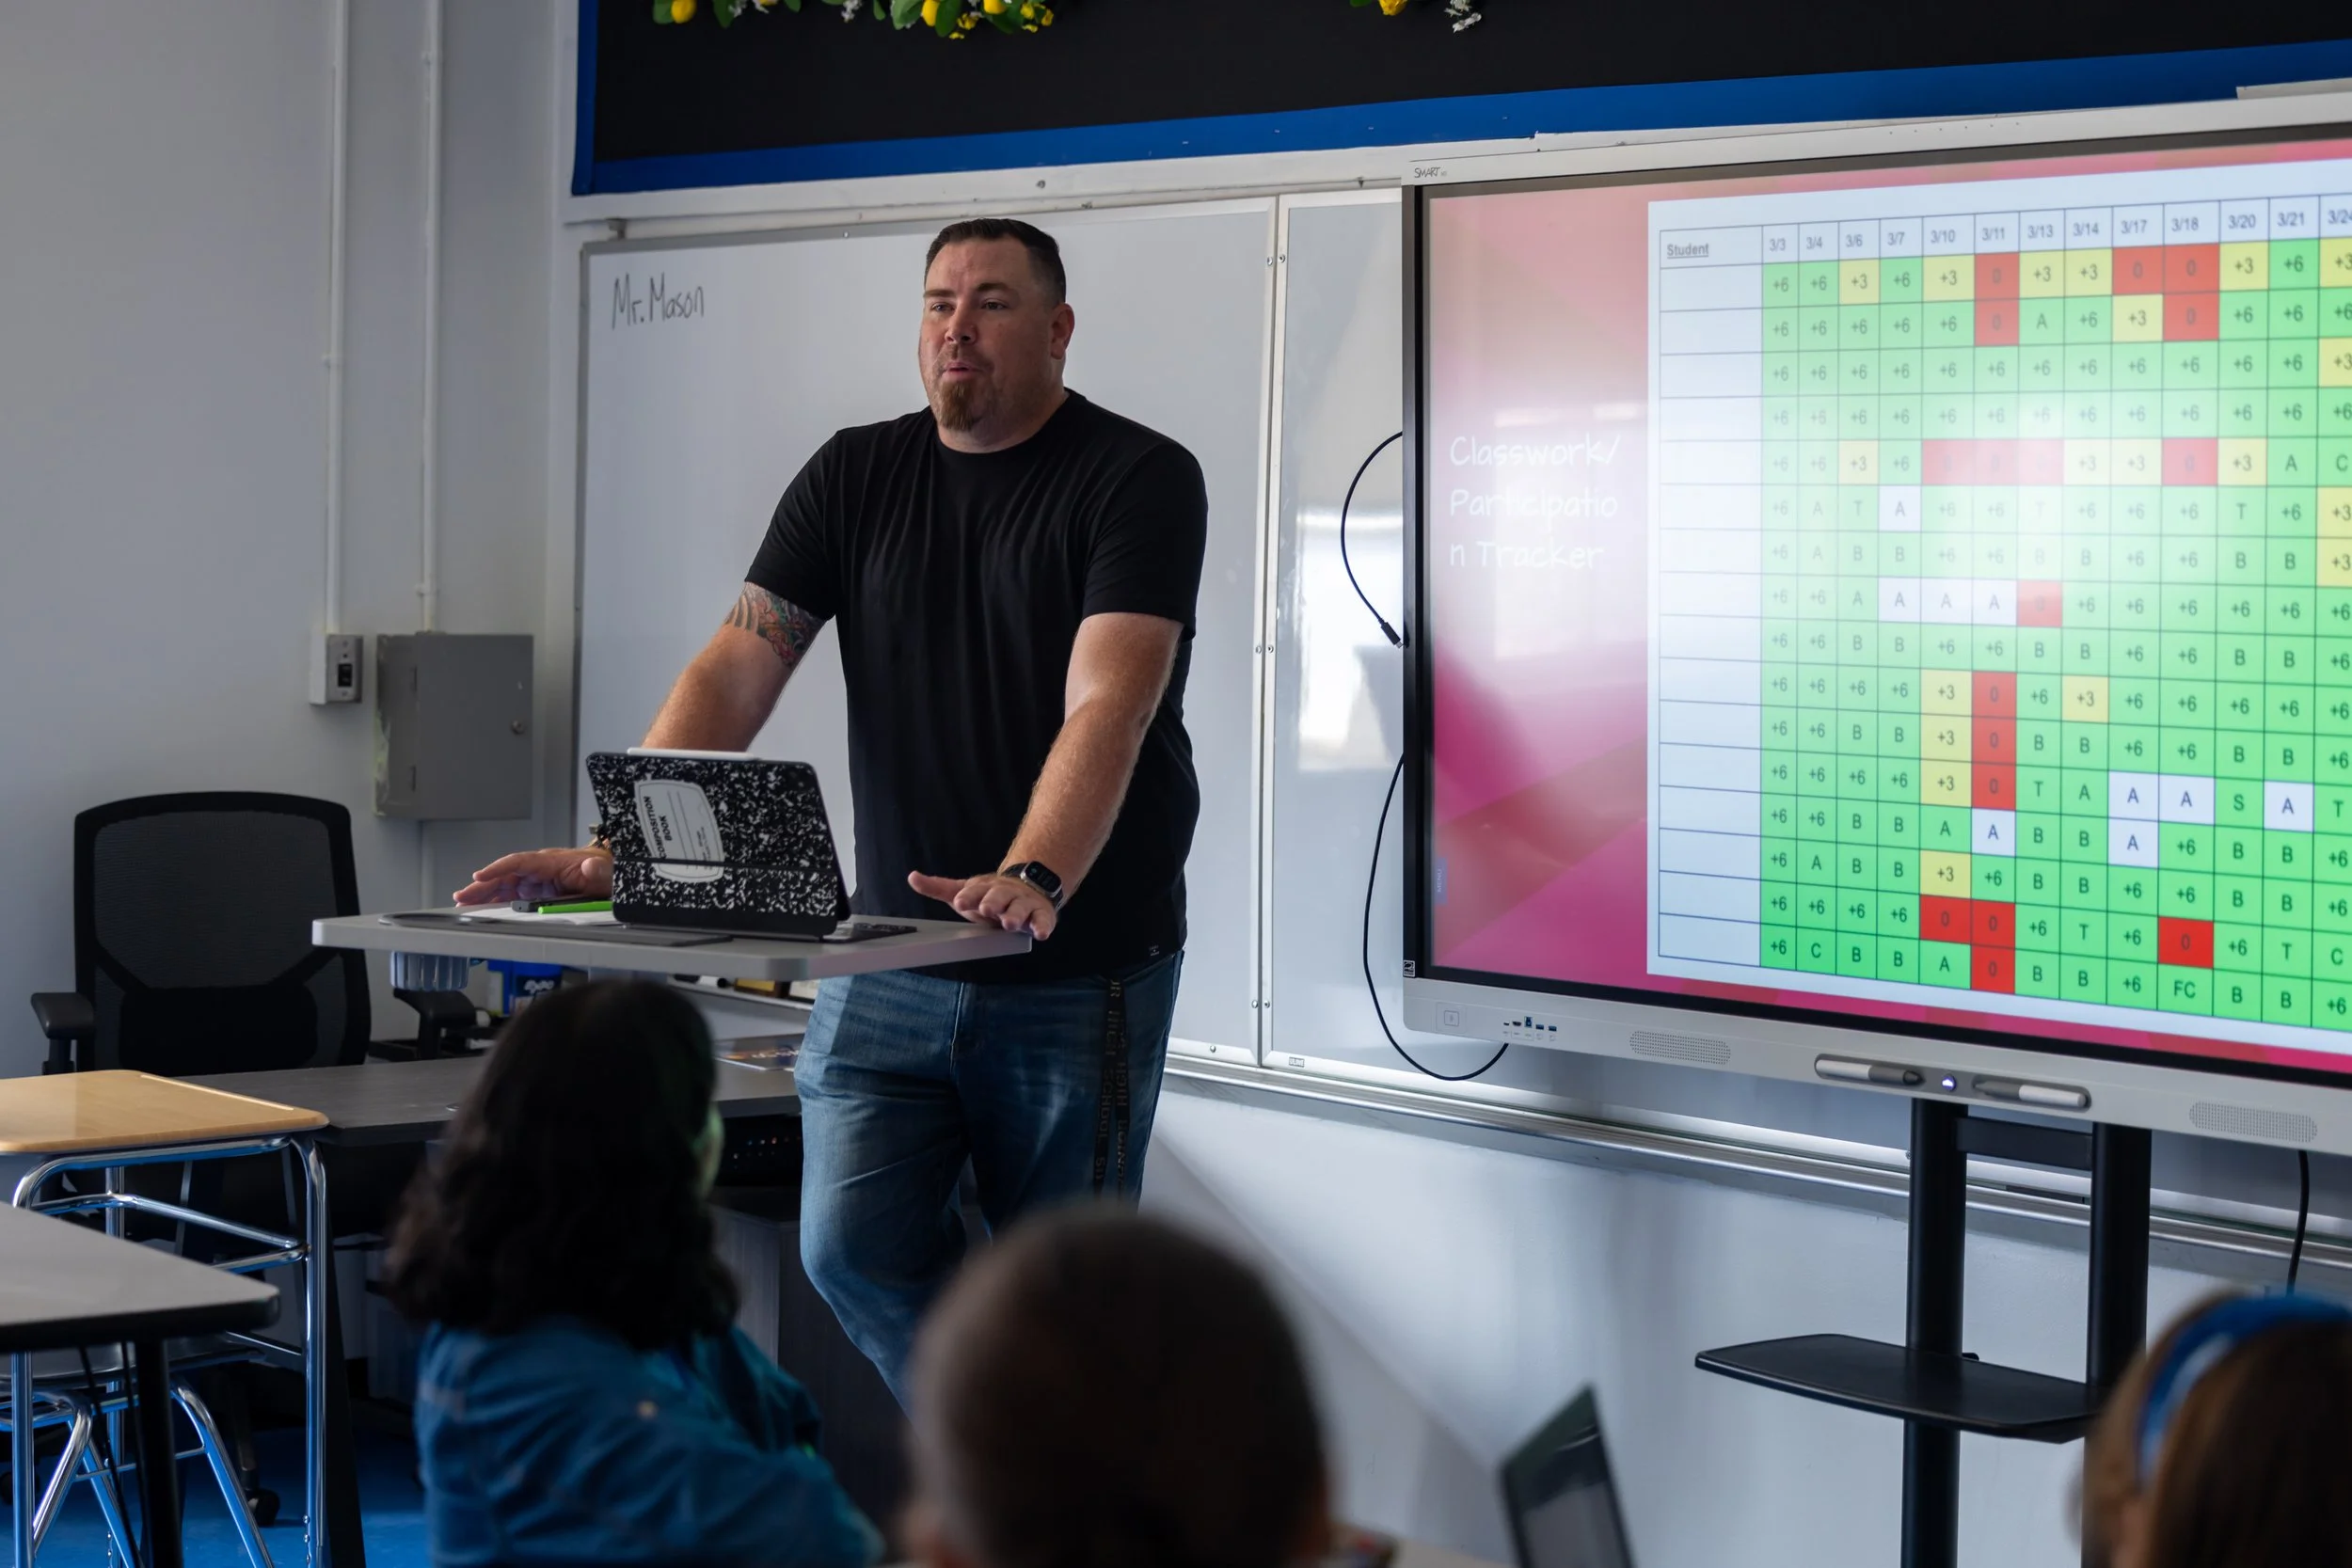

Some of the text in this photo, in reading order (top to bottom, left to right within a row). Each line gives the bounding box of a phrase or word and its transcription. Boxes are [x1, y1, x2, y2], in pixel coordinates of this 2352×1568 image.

[1414, 166, 1441, 179] SMART
[1666, 242, 1709, 258] Student
[1769, 237, 1787, 252] 3/3
[1805, 236, 1823, 250] 3/4
[1845, 233, 1864, 248] 3/6
[1887, 230, 1906, 246] 3/7
[1930, 229, 1957, 245] 3/10
[1981, 227, 2006, 242] 3/11
[2027, 223, 2055, 240] 3/13
[2073, 222, 2100, 237] 3/14
[2121, 218, 2148, 235] 3/17
[2171, 216, 2200, 232] 3/18
[2228, 214, 2257, 230] 3/20
[2277, 211, 2305, 228] 3/21
[2234, 257, 2254, 275] +3
[2283, 254, 2305, 273] +6
[2335, 252, 2352, 271] +3
[649, 271, 705, 323] Mason
[2283, 304, 2304, 323] +6
[2334, 302, 2352, 321] +6
[2282, 353, 2303, 372] +6
[2333, 352, 2352, 371] +3
[2282, 402, 2352, 421] +6 +6
[1450, 432, 1622, 467] Classwork/
[2284, 453, 2298, 472] A
[1450, 485, 1619, 533] Participatio
[2332, 503, 2352, 522] +3
[1475, 535, 1605, 570] Tracker
[2284, 551, 2296, 571] B
[2331, 553, 2352, 572] +3
[2231, 600, 2251, 618] +6
[2280, 601, 2301, 620] +6
[2330, 602, 2351, 622] +6
[2178, 646, 2199, 665] +6
[2233, 648, 2247, 667] B
[2283, 650, 2296, 669] B
[2330, 652, 2351, 671] +6
[2125, 692, 2144, 710] +6
[2177, 694, 2198, 713] +6
[2230, 697, 2250, 715] +6
[2280, 699, 2300, 718] +6
[2329, 702, 2350, 721] +6
[1937, 729, 1956, 746] +3
[2033, 734, 2045, 752] B
[2079, 736, 2090, 754] B
[2124, 739, 2144, 757] +6
[2177, 742, 2198, 761] +6
[2233, 745, 2246, 764] B
[2282, 747, 2295, 767] B
[2329, 751, 2350, 769] +6
[1771, 764, 1788, 781] +6
[1808, 766, 1826, 784] +6
[1849, 768, 1867, 786] +6
[1891, 771, 1909, 789] +6
[1937, 774, 1955, 792] +3
[2033, 780, 2044, 798] T
[2078, 784, 2091, 801] A
[2126, 786, 2139, 804] A
[2180, 790, 2193, 808] A
[2233, 793, 2246, 812] S
[2281, 797, 2295, 815] A
[2332, 799, 2344, 818] T
[660, 815, 674, 842] BOOK
[1771, 808, 2349, 868] +6 +6 B B A A B B A +6 B B +6
[1771, 851, 2348, 917] +6 A B B +3 +6 B B +6 +6 B B +6
[1771, 895, 1788, 911] +6
[1808, 898, 1825, 915] +6
[1848, 902, 1867, 919] +6
[1890, 906, 1908, 924] +6
[2028, 919, 2047, 937] +6
[2078, 923, 2090, 941] T
[2123, 928, 2142, 946] +6
[2228, 938, 2249, 957] +6
[2280, 942, 2293, 960] T
[2329, 946, 2344, 966] C
[1770, 939, 1788, 956] +6
[1810, 942, 1822, 959] C
[1851, 945, 1862, 963] B
[1893, 950, 1904, 968] B
[1938, 956, 1951, 973] A
[2032, 964, 2043, 983] B
[2077, 969, 2090, 988] B
[2122, 975, 2142, 993] +6
[2173, 979, 2197, 1000] FC
[2231, 985, 2244, 1005] B
[2280, 990, 2293, 1009] B
[2327, 996, 2347, 1016] +6
